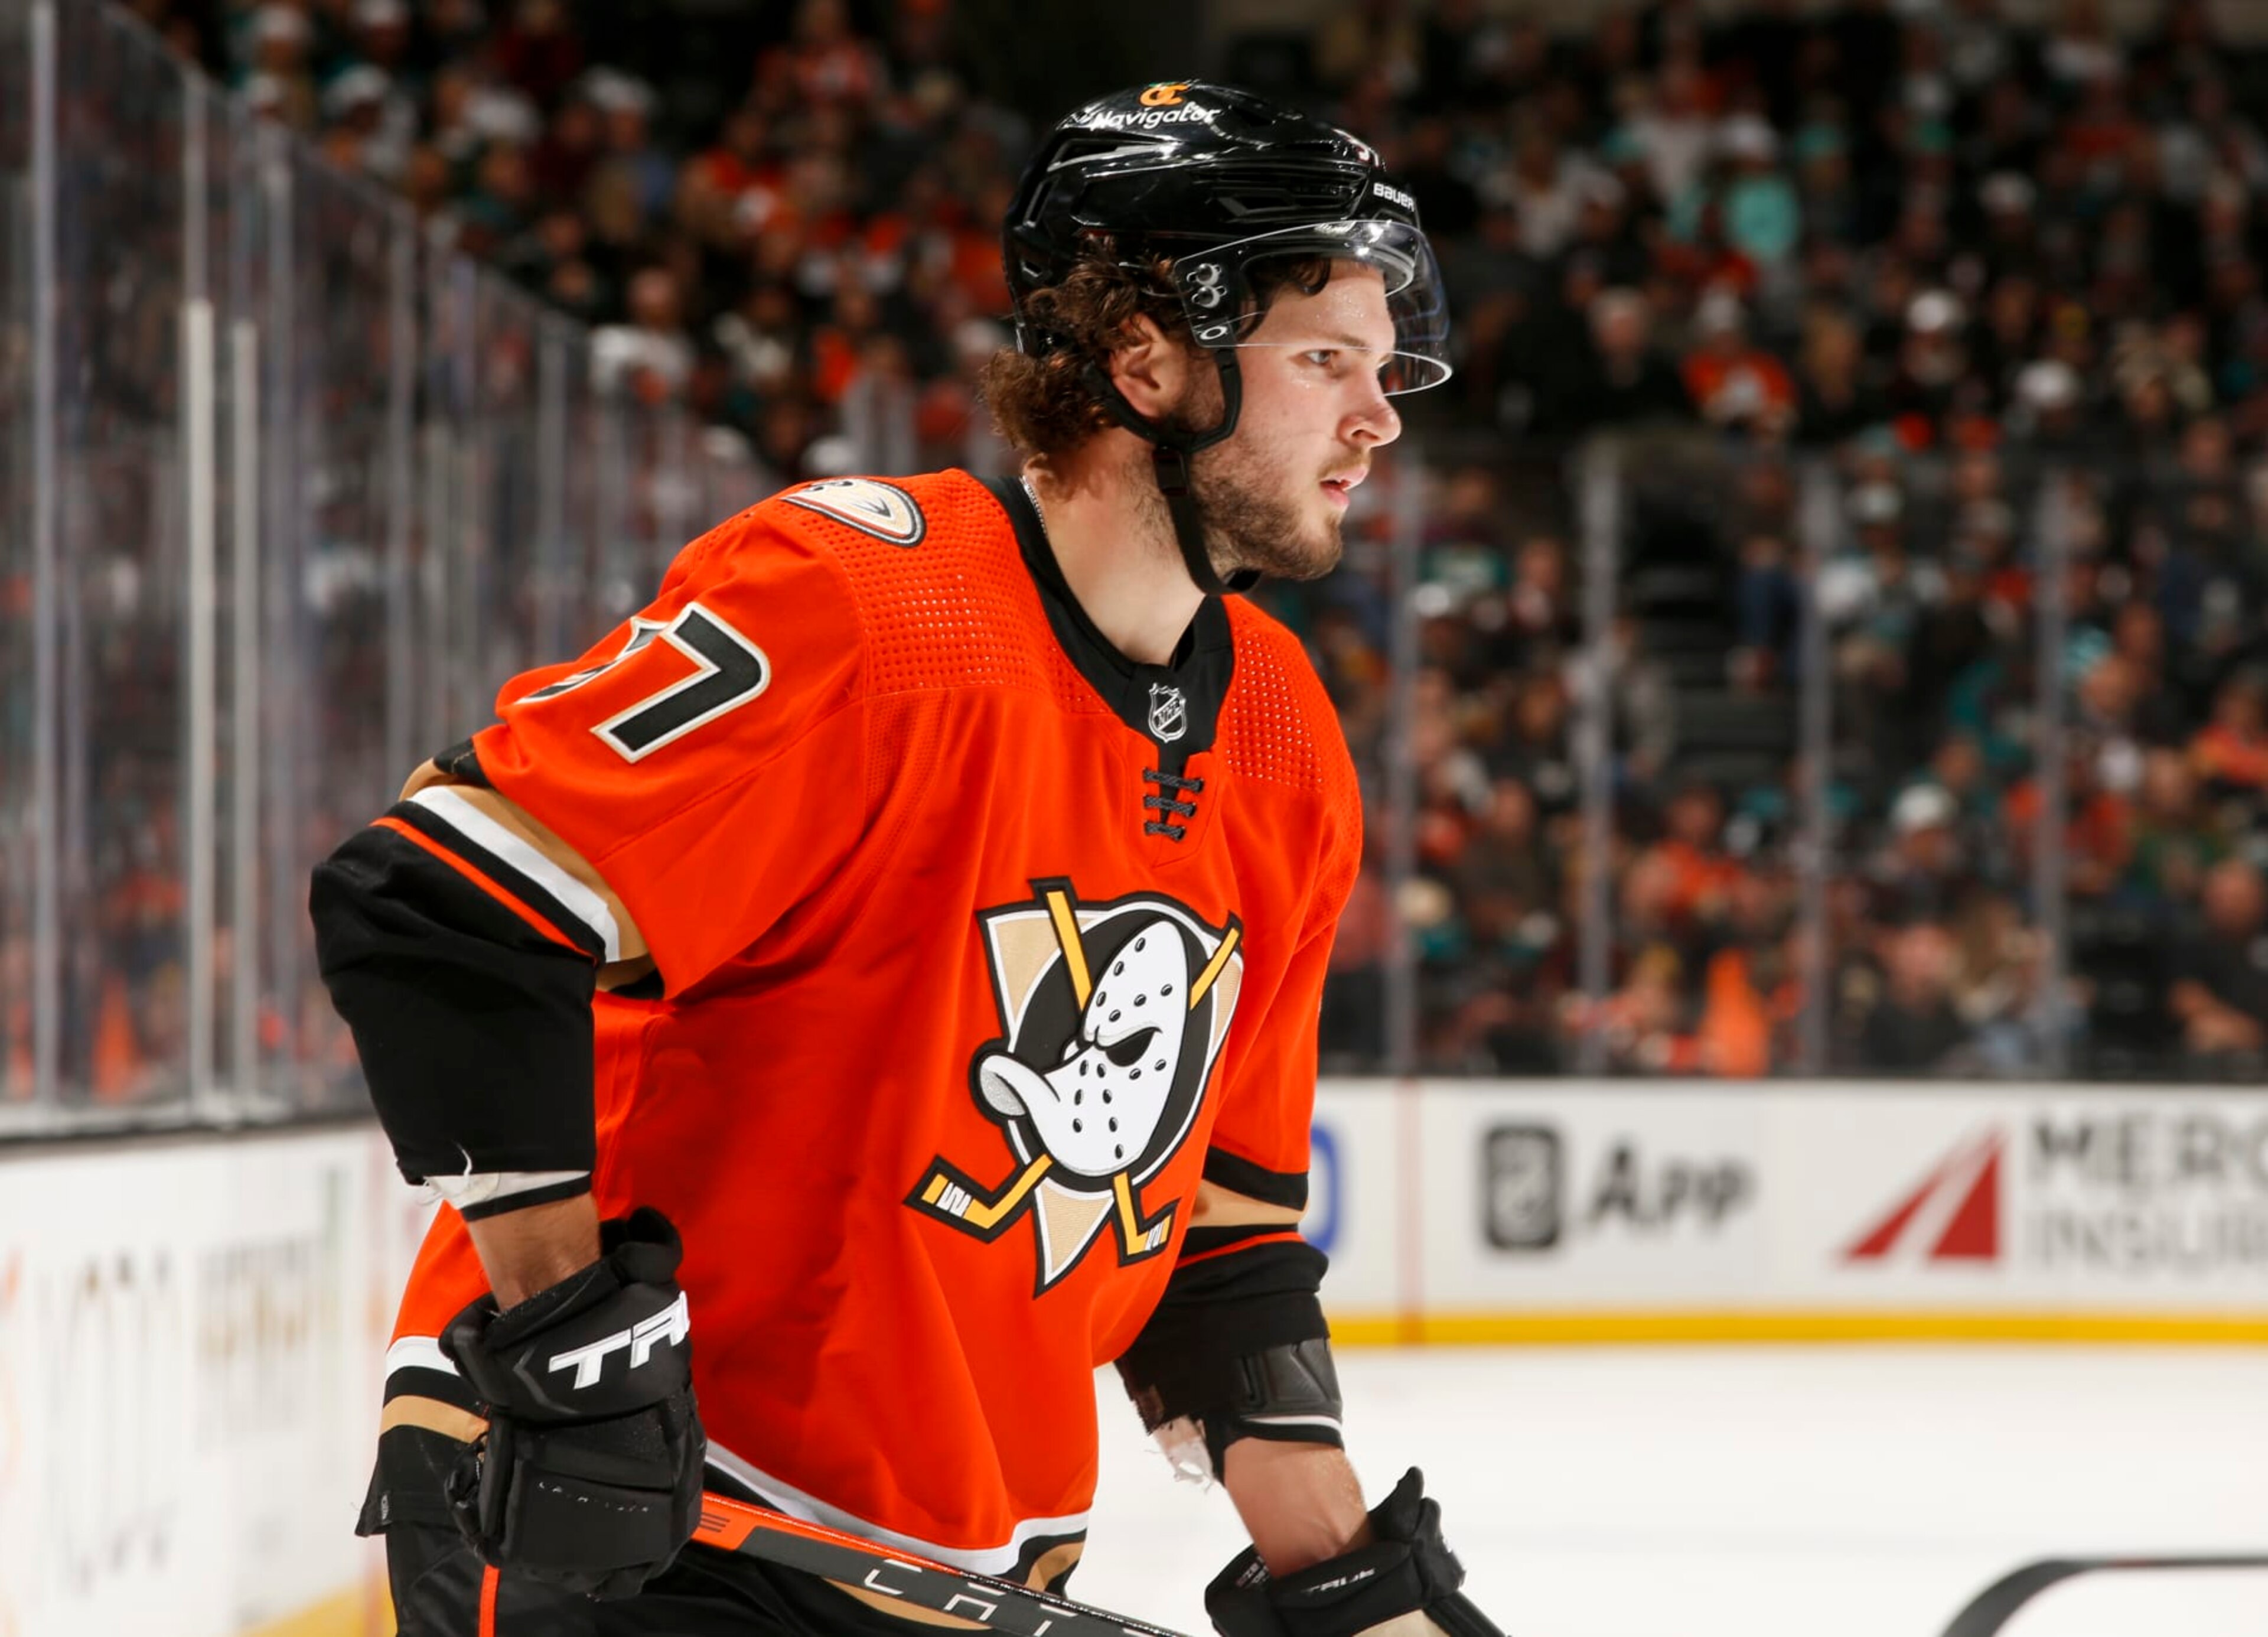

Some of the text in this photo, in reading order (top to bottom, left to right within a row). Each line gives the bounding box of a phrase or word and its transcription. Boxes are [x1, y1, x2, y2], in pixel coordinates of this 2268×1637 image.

[1091, 101, 1220, 129] Navigator
[1589, 1138, 1754, 1235] App
[548, 1290, 690, 1390] TR
